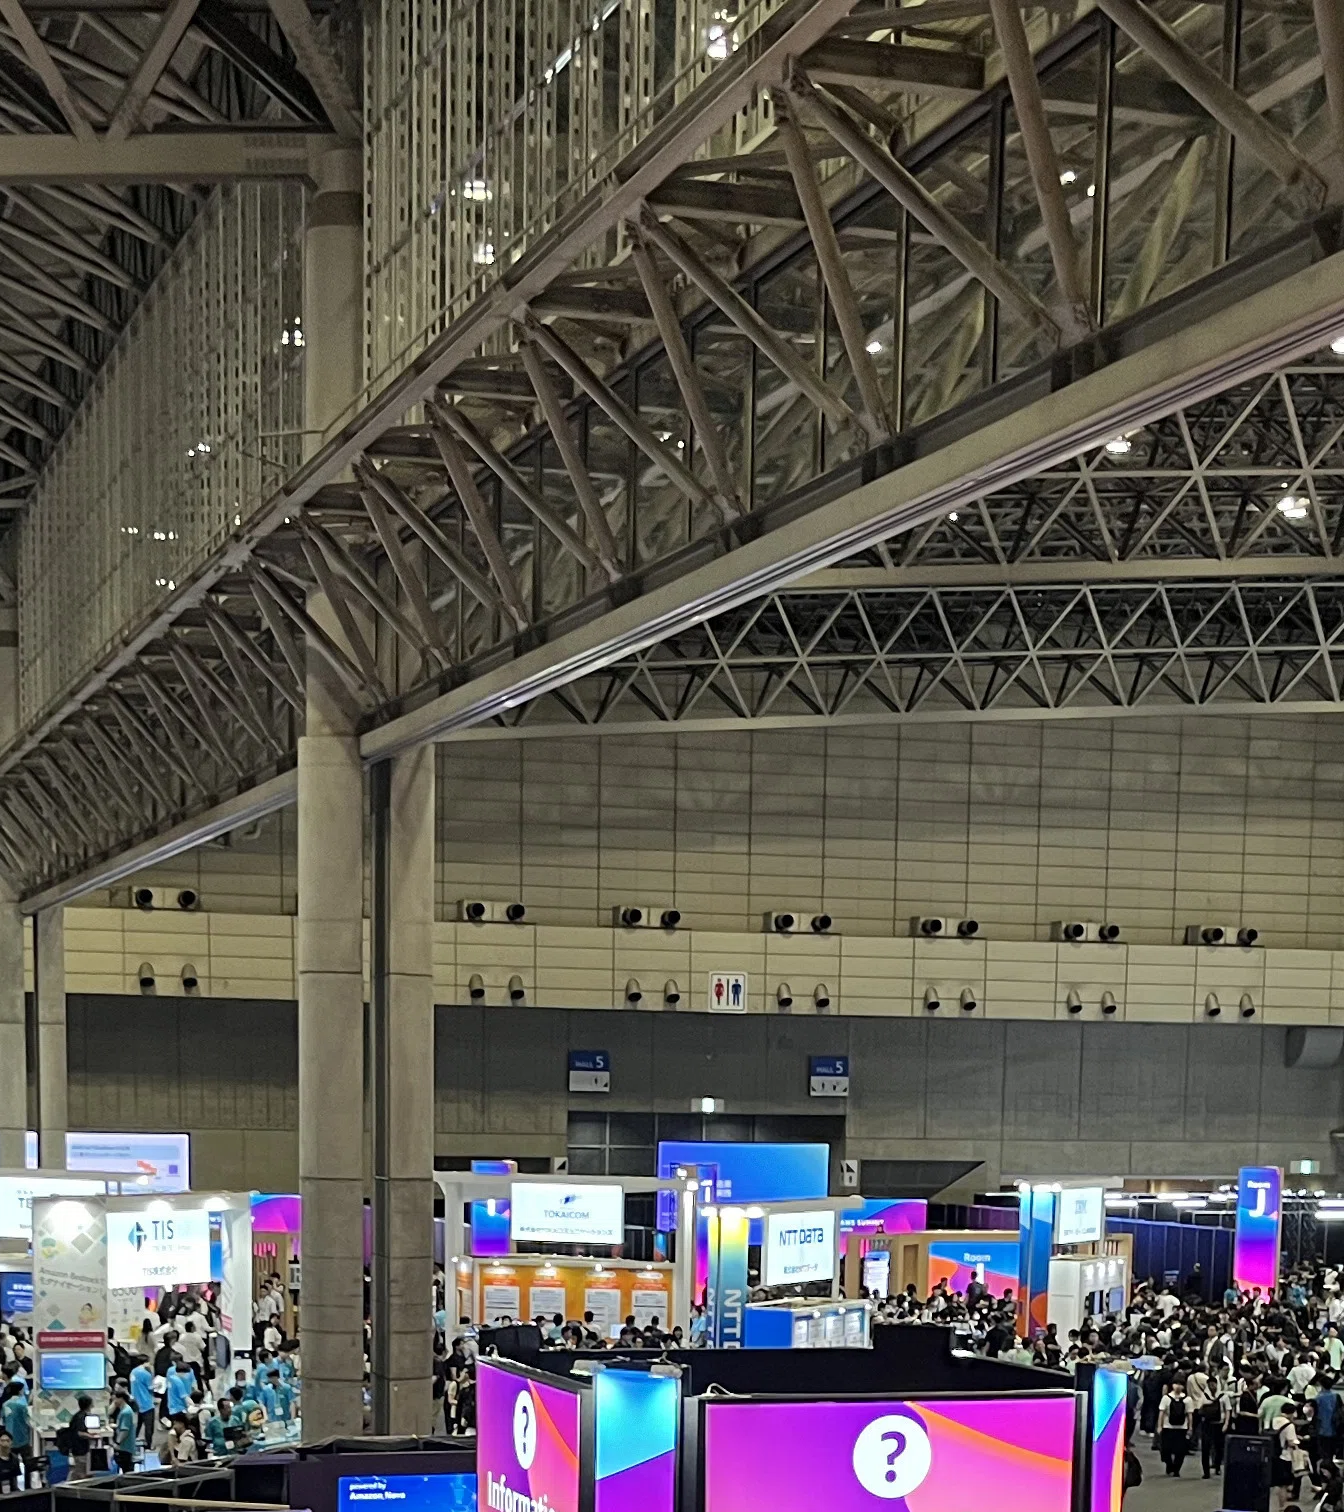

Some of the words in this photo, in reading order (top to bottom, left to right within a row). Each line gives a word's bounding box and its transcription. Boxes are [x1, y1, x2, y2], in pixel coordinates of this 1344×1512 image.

[595, 1055, 604, 1069] 5
[834, 1060, 844, 1074] 5
[1248, 1188, 1266, 1218] J
[151, 1219, 175, 1241] TIS
[779, 1229, 799, 1247] NTT
[963, 1252, 991, 1262] Room
[349, 1491, 384, 1501] Amazon
